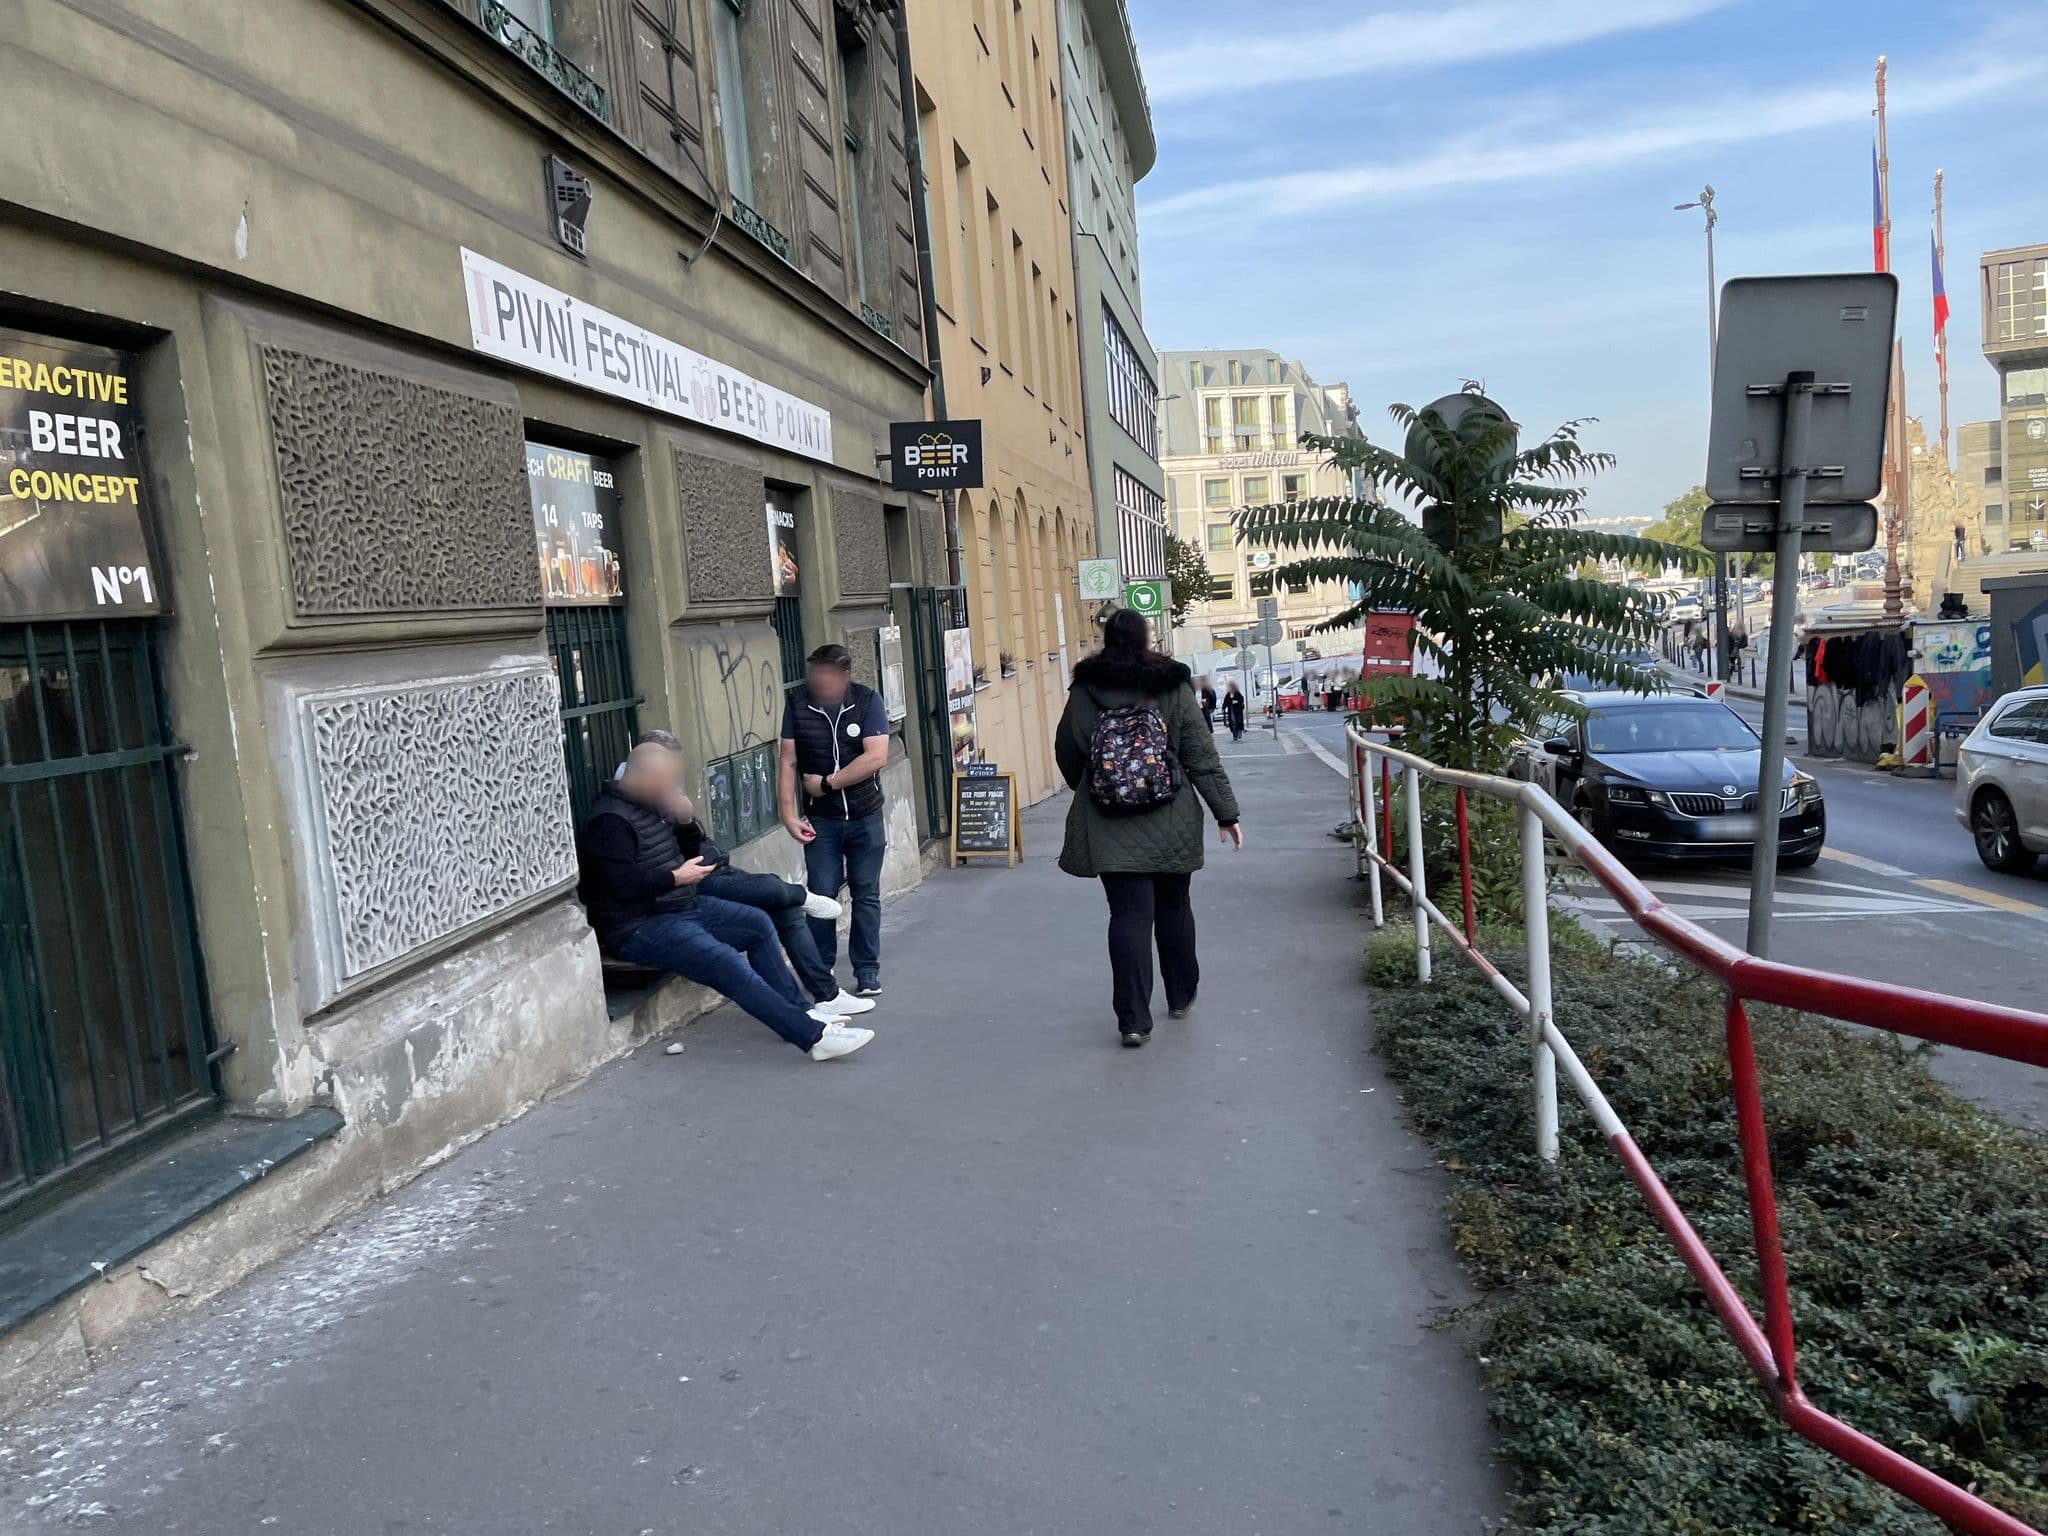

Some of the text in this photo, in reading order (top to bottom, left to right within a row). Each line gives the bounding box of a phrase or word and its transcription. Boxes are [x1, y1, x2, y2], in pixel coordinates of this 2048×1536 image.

[493, 280, 822, 451] PIVNÍ FESTIVAL BEER POINT
[29, 410, 124, 459] BEER
[546, 453, 590, 484] CRAFT
[593, 470, 613, 489] BEER
[904, 444, 968, 466] BEER
[918, 466, 958, 478] POINT
[9, 468, 139, 505] CONCEPT
[542, 503, 603, 529] 14 TAPS
